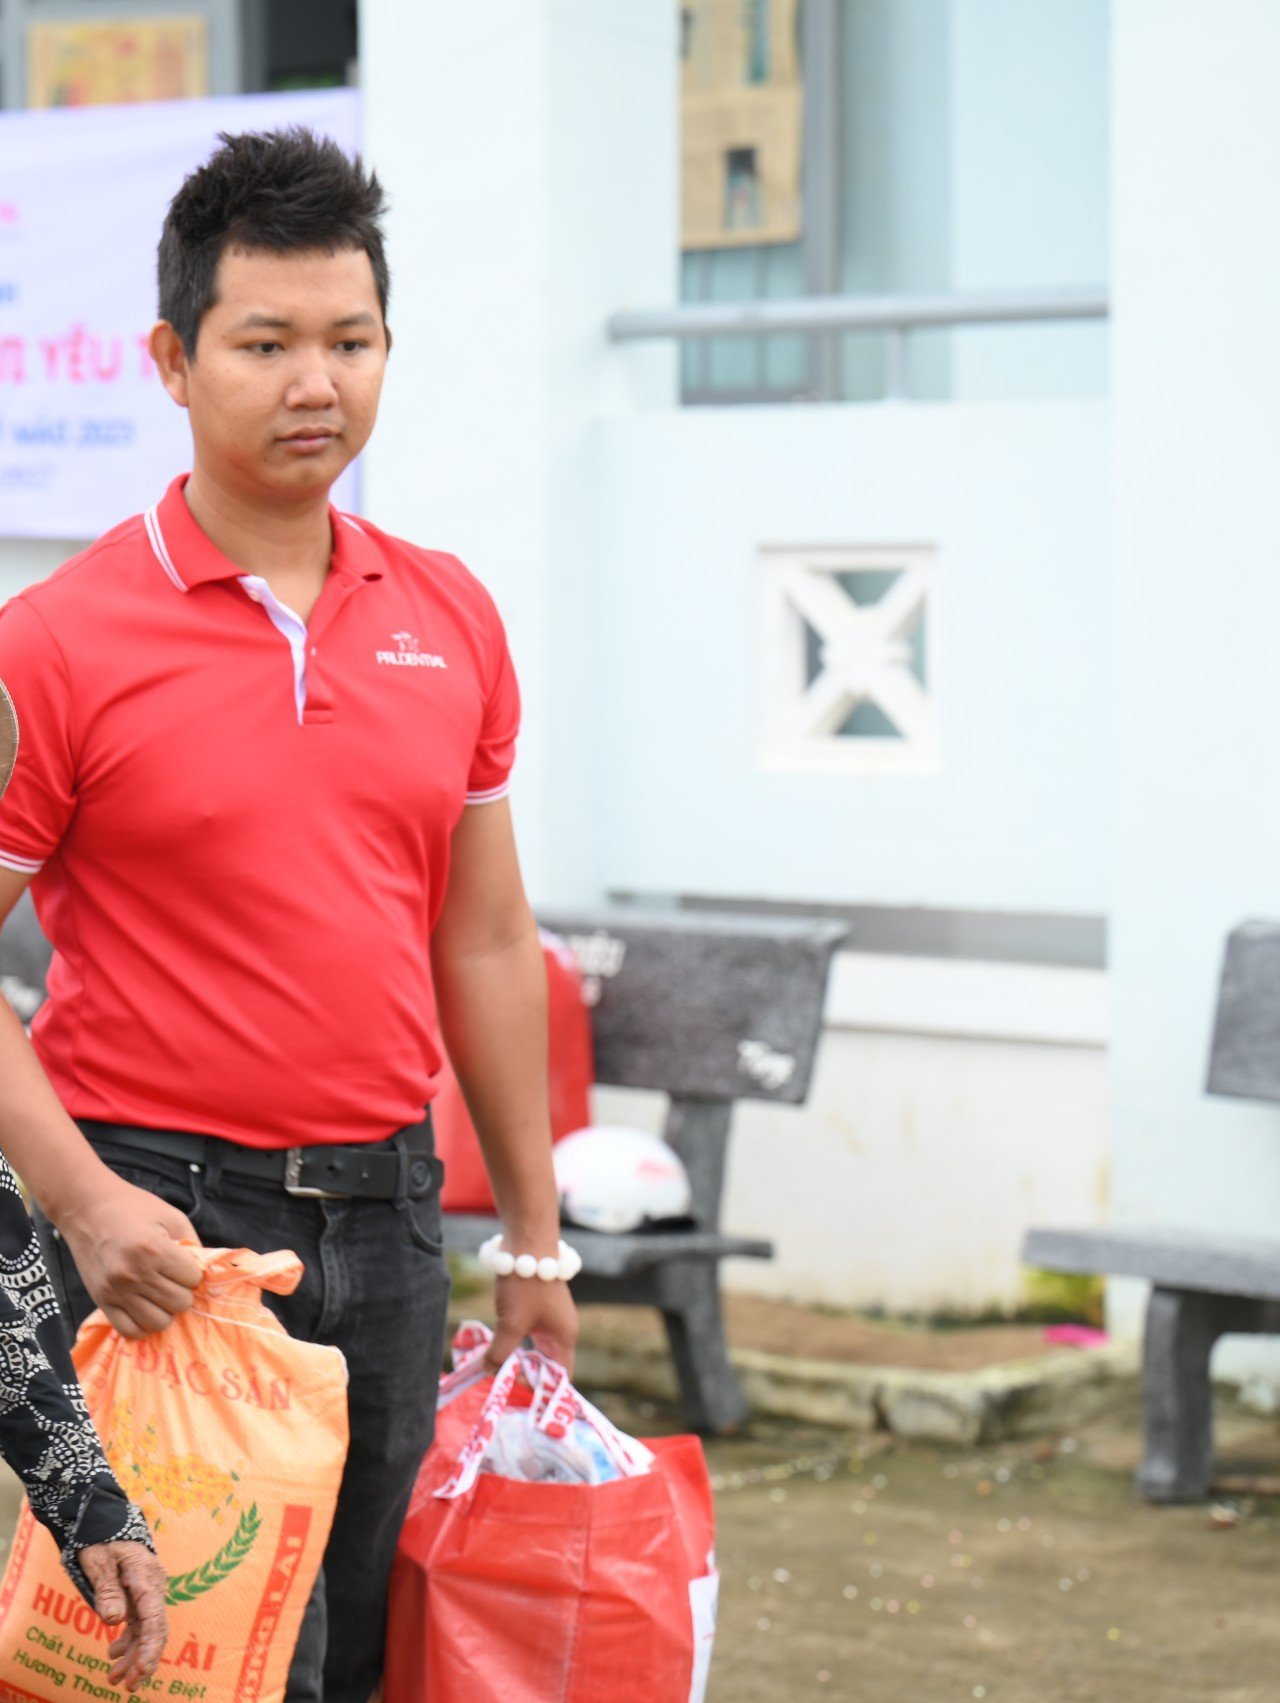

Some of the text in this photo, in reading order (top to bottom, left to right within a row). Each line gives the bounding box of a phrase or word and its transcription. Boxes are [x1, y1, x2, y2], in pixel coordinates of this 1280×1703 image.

[375, 650, 448, 669] PRUDENTIAL
[31, 1582, 122, 1646] HƯƠN
[25, 1625, 64, 1655] Chất
[65, 1645, 112, 1674] Lượn
[168, 1679, 207, 1701] Biệt
